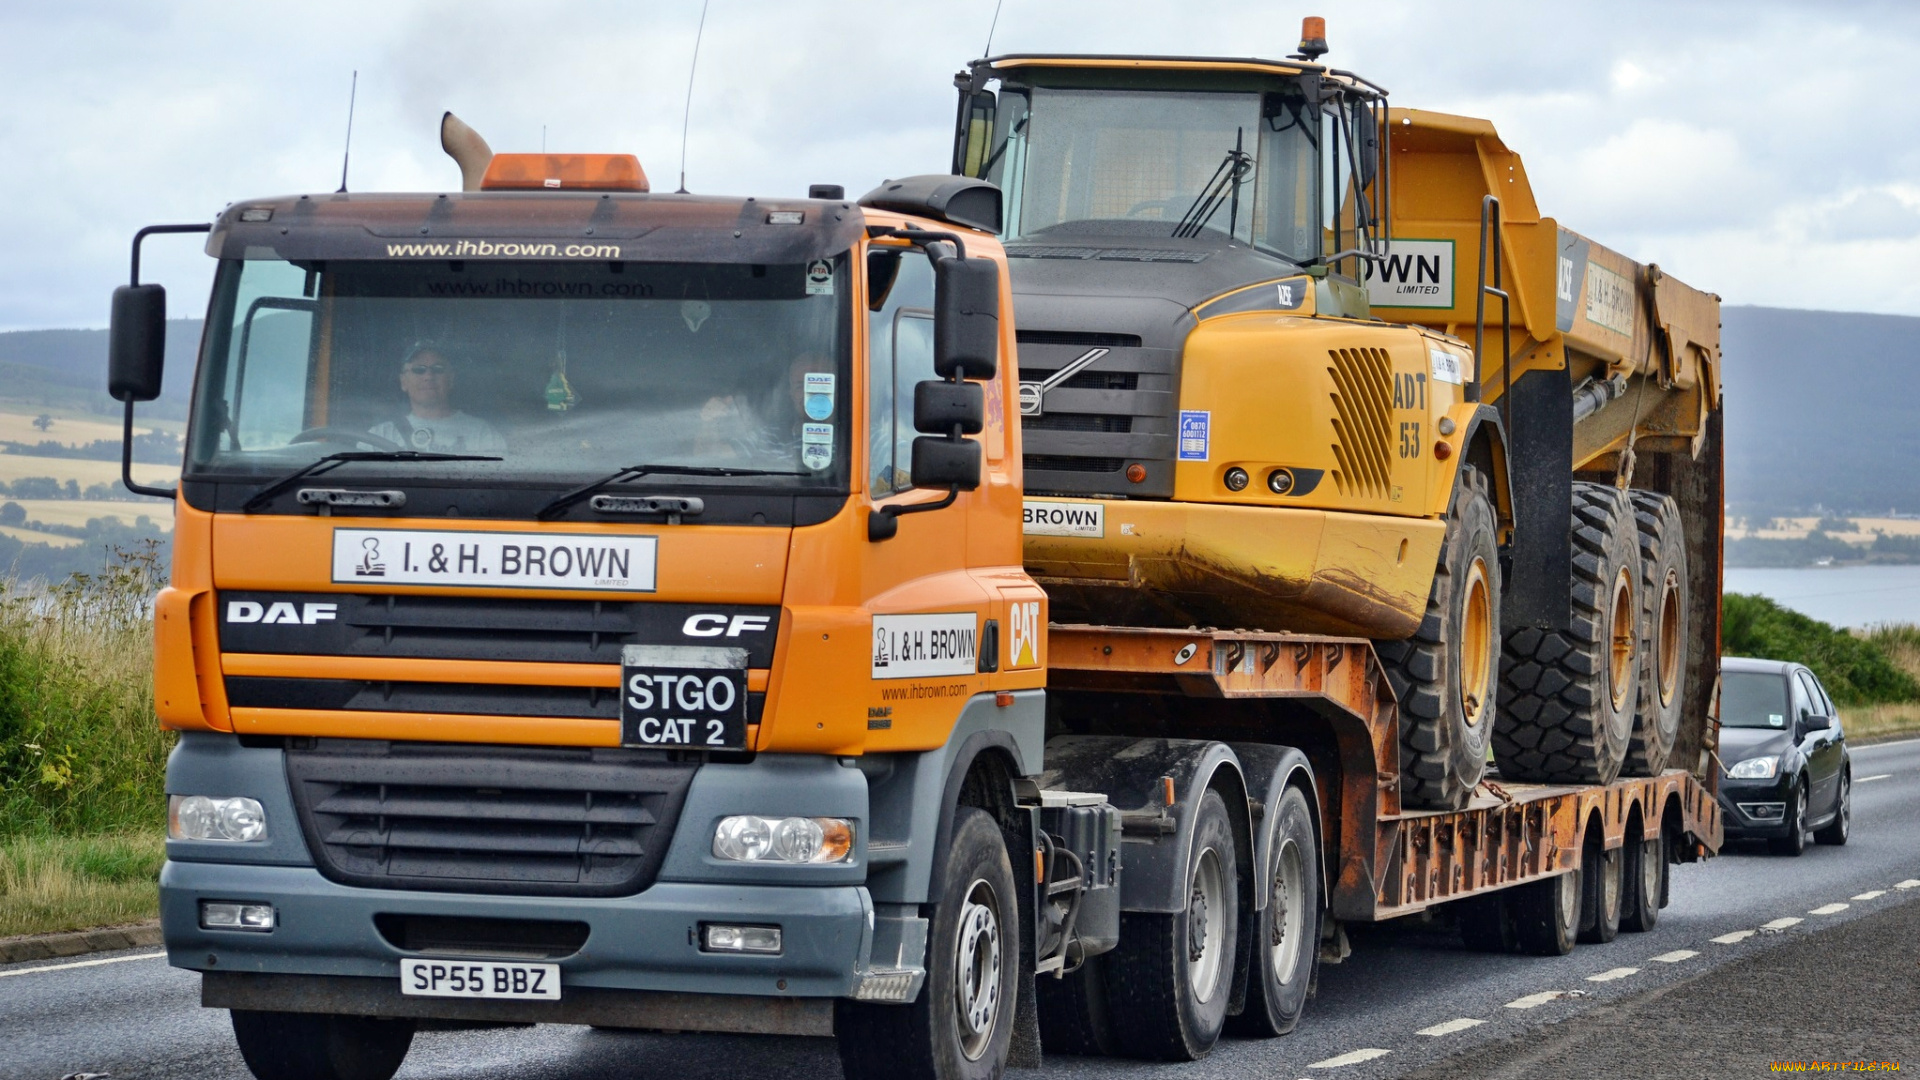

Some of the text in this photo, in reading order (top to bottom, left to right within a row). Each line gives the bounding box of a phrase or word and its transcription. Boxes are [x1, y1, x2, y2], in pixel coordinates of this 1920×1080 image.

[387, 240, 620, 258] www.ihbrown.com
[813, 267, 827, 275] FTA
[428, 278, 654, 297] www.ihbrown.com
[1396, 285, 1440, 294] LIMITED
[1393, 372, 1426, 410] ADT
[1190, 421, 1206, 430] 0870
[1399, 422, 1420, 459] 53
[1023, 508, 1098, 526] BROWN
[404, 542, 631, 579] I. & H. BROWN
[594, 578, 630, 587] LIMITED
[227, 602, 338, 625] DAF
[682, 613, 771, 637] CF
[891, 629, 976, 662] I. & H. BROWN
[1010, 602, 1040, 666] CAT
[628, 674, 736, 712] STGO
[882, 683, 968, 700] www.ihbrown.com
[639, 718, 725, 745] CAT 2
[413, 964, 547, 994] SP55 BBZ
